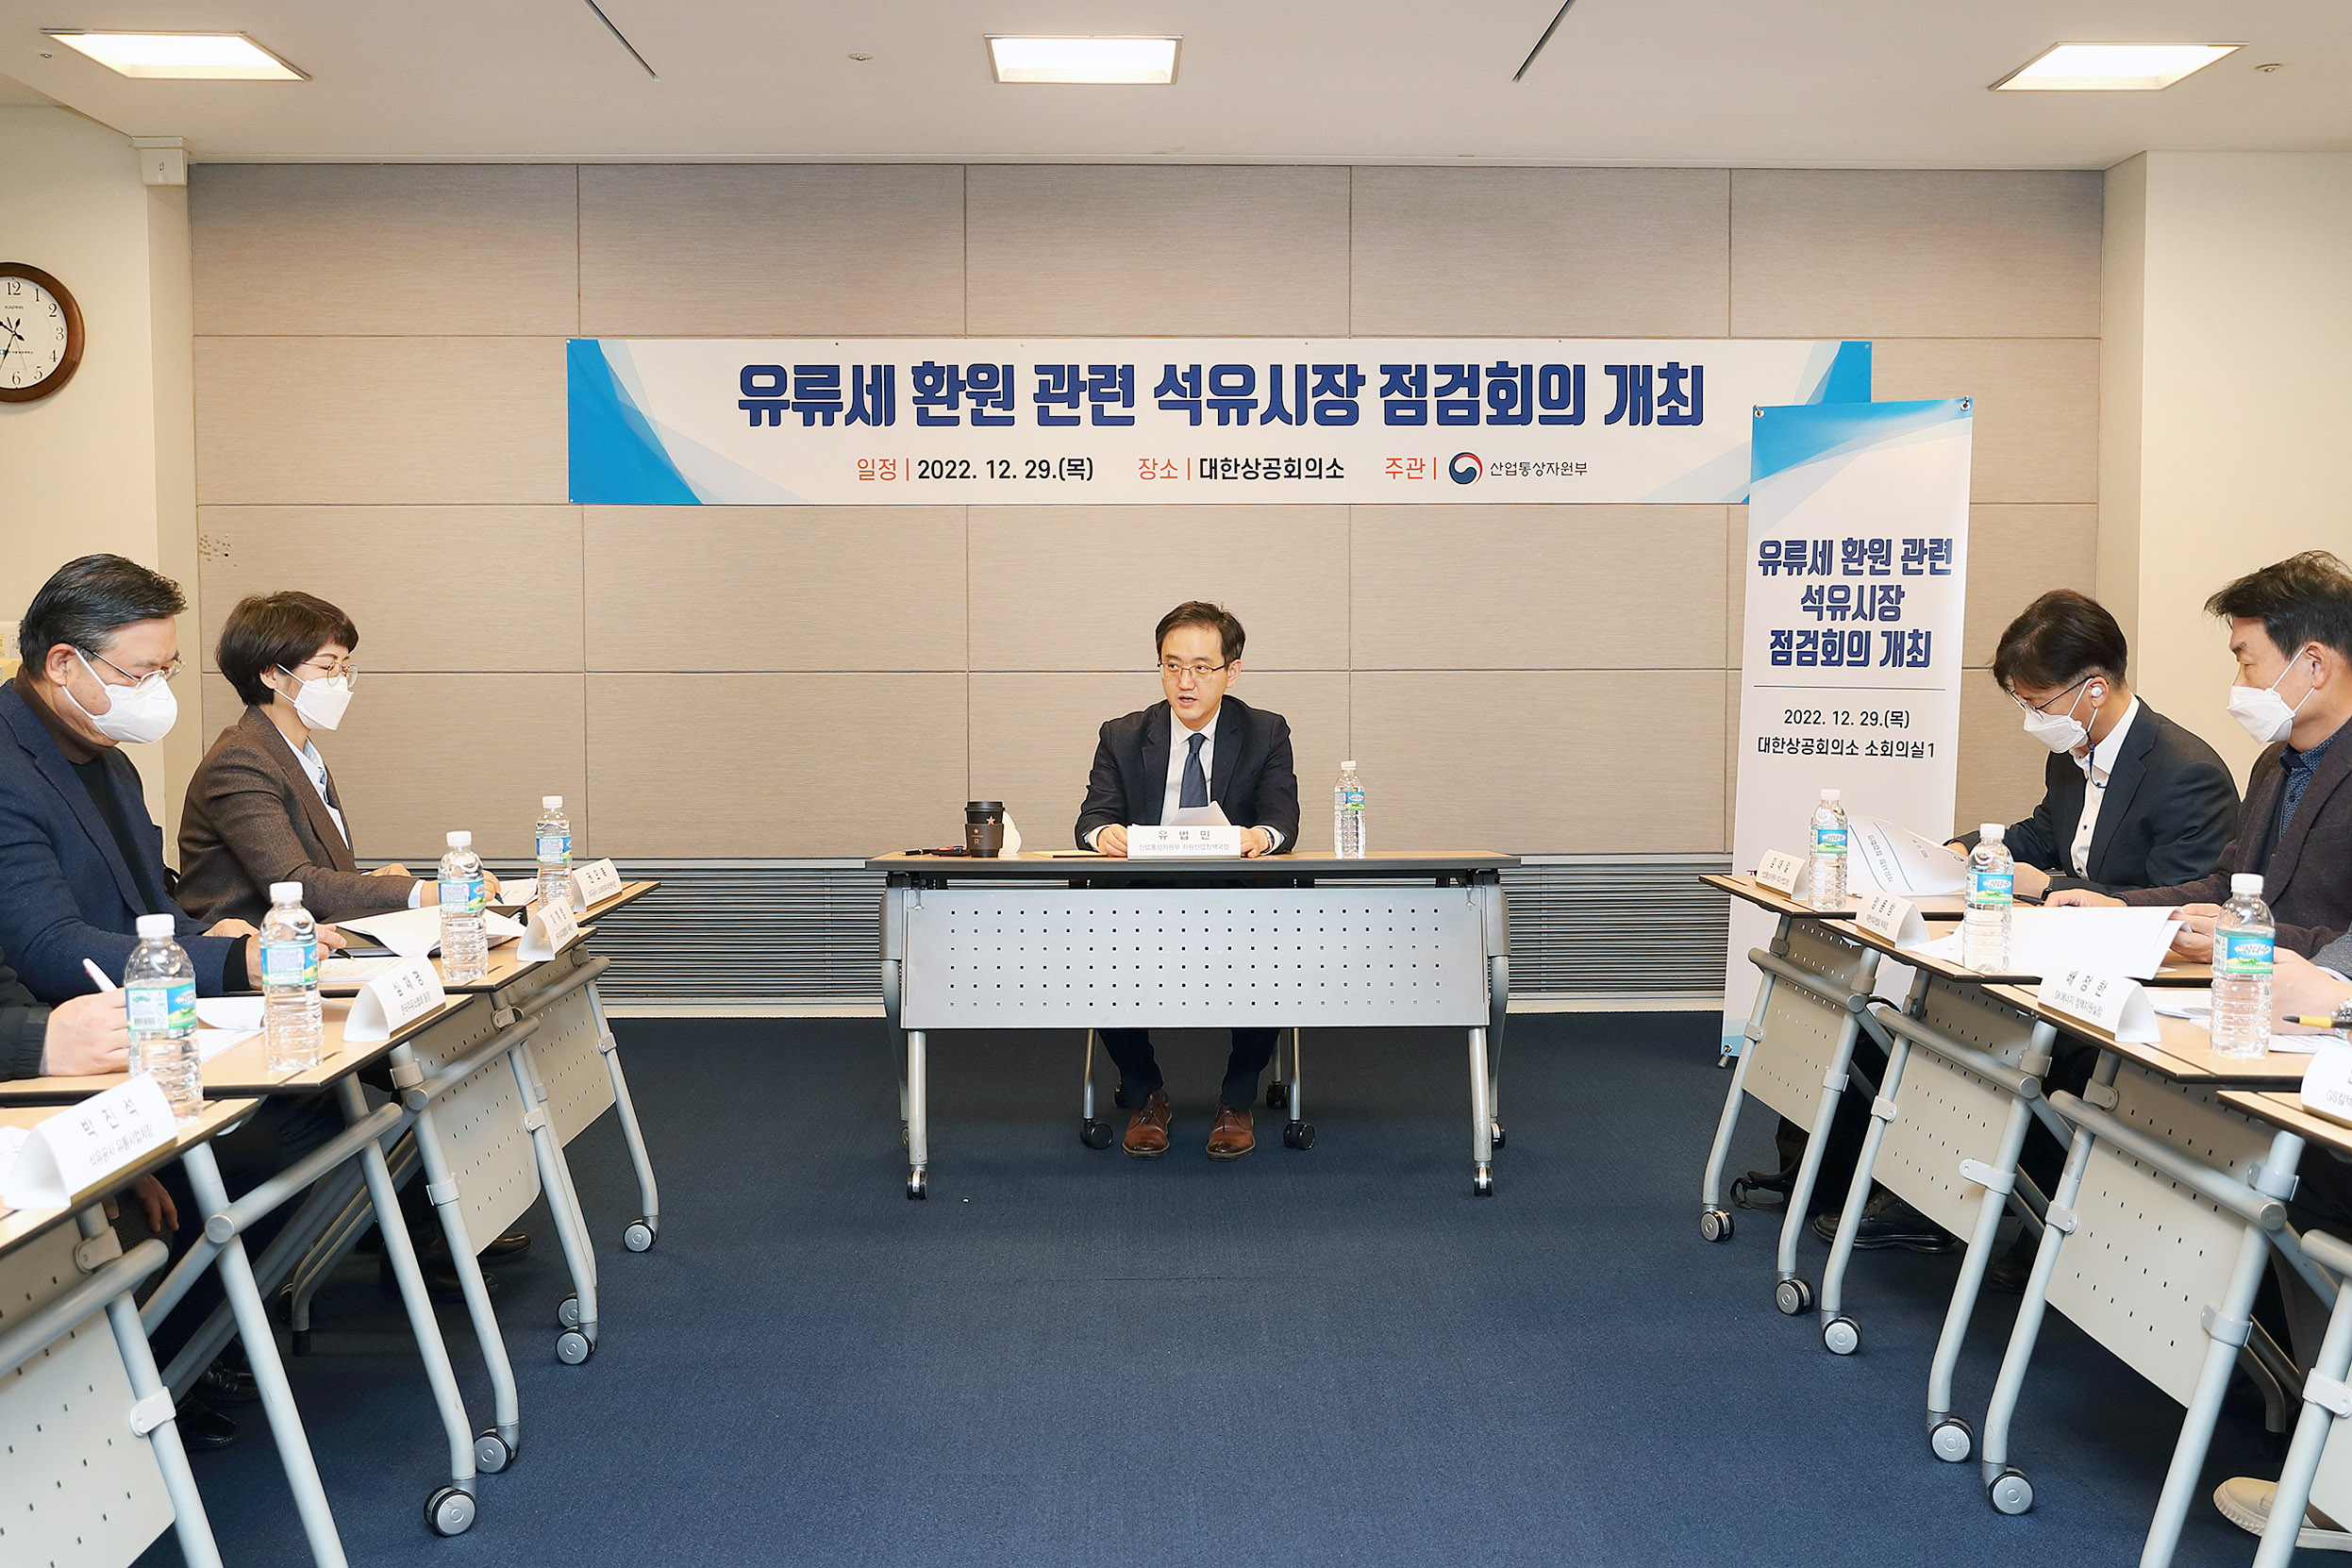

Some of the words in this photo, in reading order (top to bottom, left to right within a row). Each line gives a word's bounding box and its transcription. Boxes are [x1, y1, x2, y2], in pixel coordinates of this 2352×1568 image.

[7, 281, 21, 296] 12
[35, 288, 41, 302] 1
[48, 303, 58, 318] 2
[55, 326, 64, 341] 3
[49, 349, 58, 363] 4
[11, 371, 22, 386] 6
[34, 366, 43, 380] 5
[737, 362, 896, 427] 유류세
[910, 360, 1016, 427] 환원
[1032, 363, 1135, 427] 관련
[1153, 363, 1366, 427] 석유시장
[1379, 360, 1586, 427] 점검회의
[1603, 361, 1705, 427] 개최
[857, 458, 897, 481] 일정
[917, 459, 977, 480] 2022.
[985, 459, 1017, 479] 12.
[1024, 457, 1093, 482] 29.(목)
[1138, 458, 1178, 481] 장소
[1199, 457, 1345, 481] 대한상공회의소
[1384, 458, 1426, 480] 주관
[1490, 461, 1589, 477] 산업통상자원부
[1758, 539, 1834, 576] 유류세
[1841, 537, 1893, 576] 환원
[1900, 538, 1953, 576] 관련
[1800, 584, 1905, 622] 석유시장
[1769, 628, 1872, 668] 점검회의
[1878, 628, 1932, 669] 개최
[1783, 709, 1827, 726] 2022.
[1832, 709, 1855, 726] 12.
[1860, 709, 1910, 729] 29.(목)
[1758, 736, 1860, 757] 대한상공회의소
